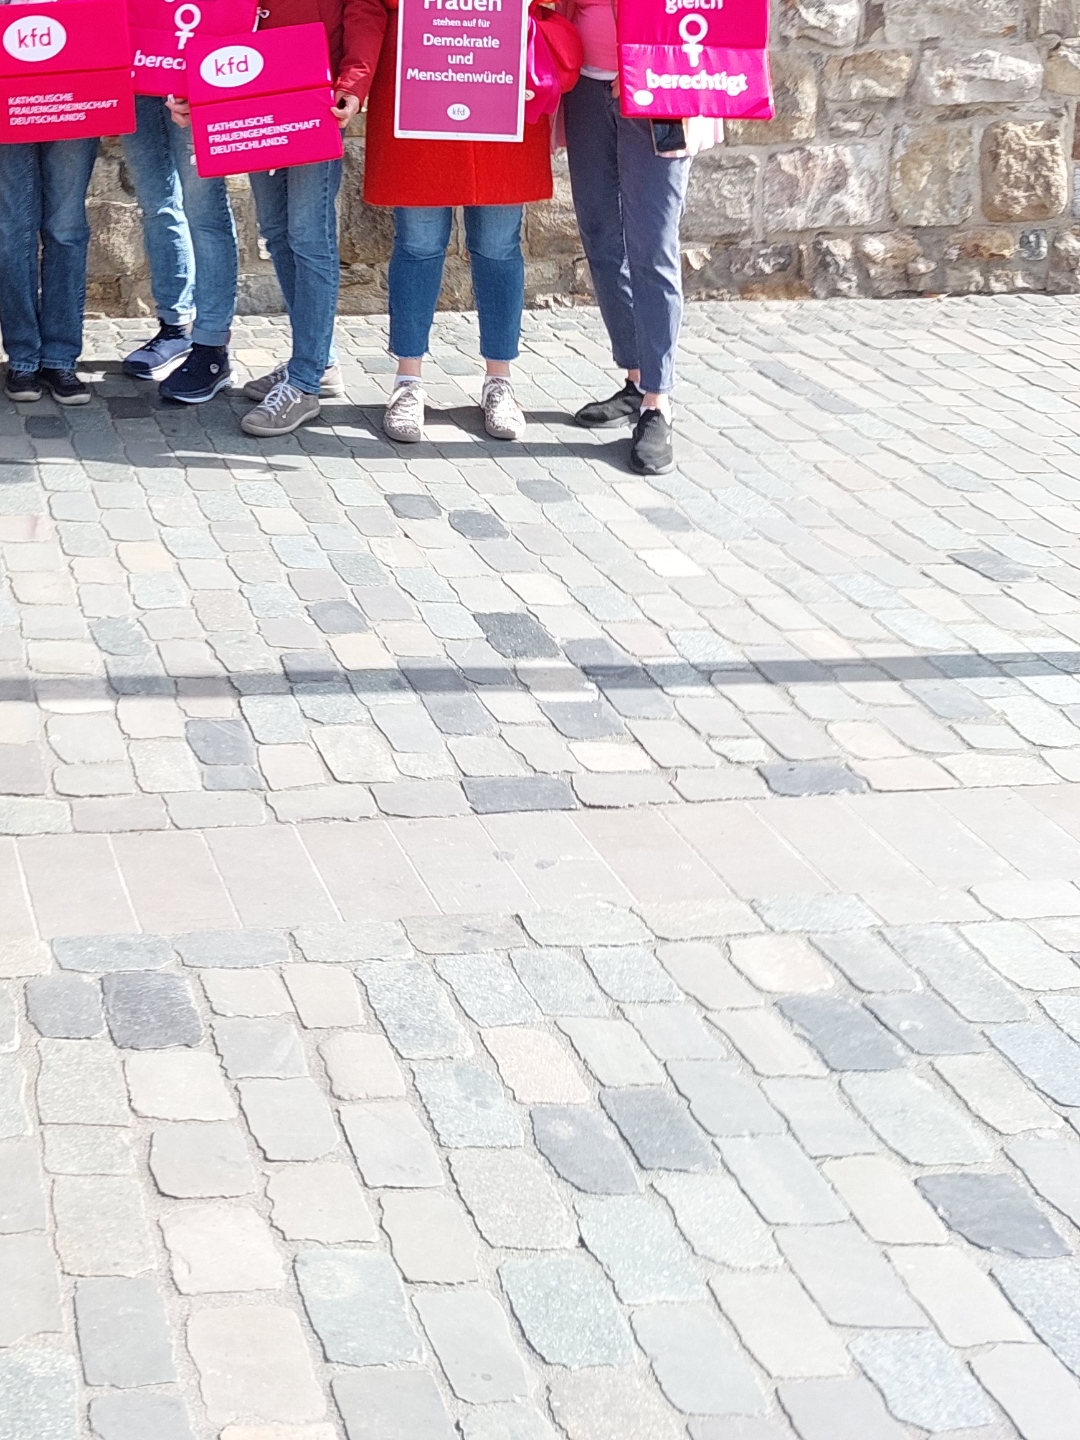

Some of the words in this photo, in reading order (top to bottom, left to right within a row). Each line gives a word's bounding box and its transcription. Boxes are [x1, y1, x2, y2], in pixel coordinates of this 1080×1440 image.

[432, 17, 461, 27] stehen
[462, 18, 477, 27] auf
[477, 18, 491, 28] für
[17, 26, 52, 49] kfd
[422, 33, 500, 48] Demokratie
[214, 54, 249, 77] kfd
[447, 52, 474, 65] und
[406, 68, 514, 85] Menschenwürde
[645, 67, 749, 96] berechtigt
[7, 92, 74, 106] KATHOLISCHE
[8, 99, 119, 116] FRAUENGEMEINSCHAFT
[9, 111, 87, 126] DEUTSCHLANDS
[451, 107, 466, 116] kfd
[206, 114, 274, 133] KATHOLISCHE
[208, 118, 321, 144] FRAUENGEMEINSCHAFT
[210, 135, 289, 155] DEUTSCHLANDS
